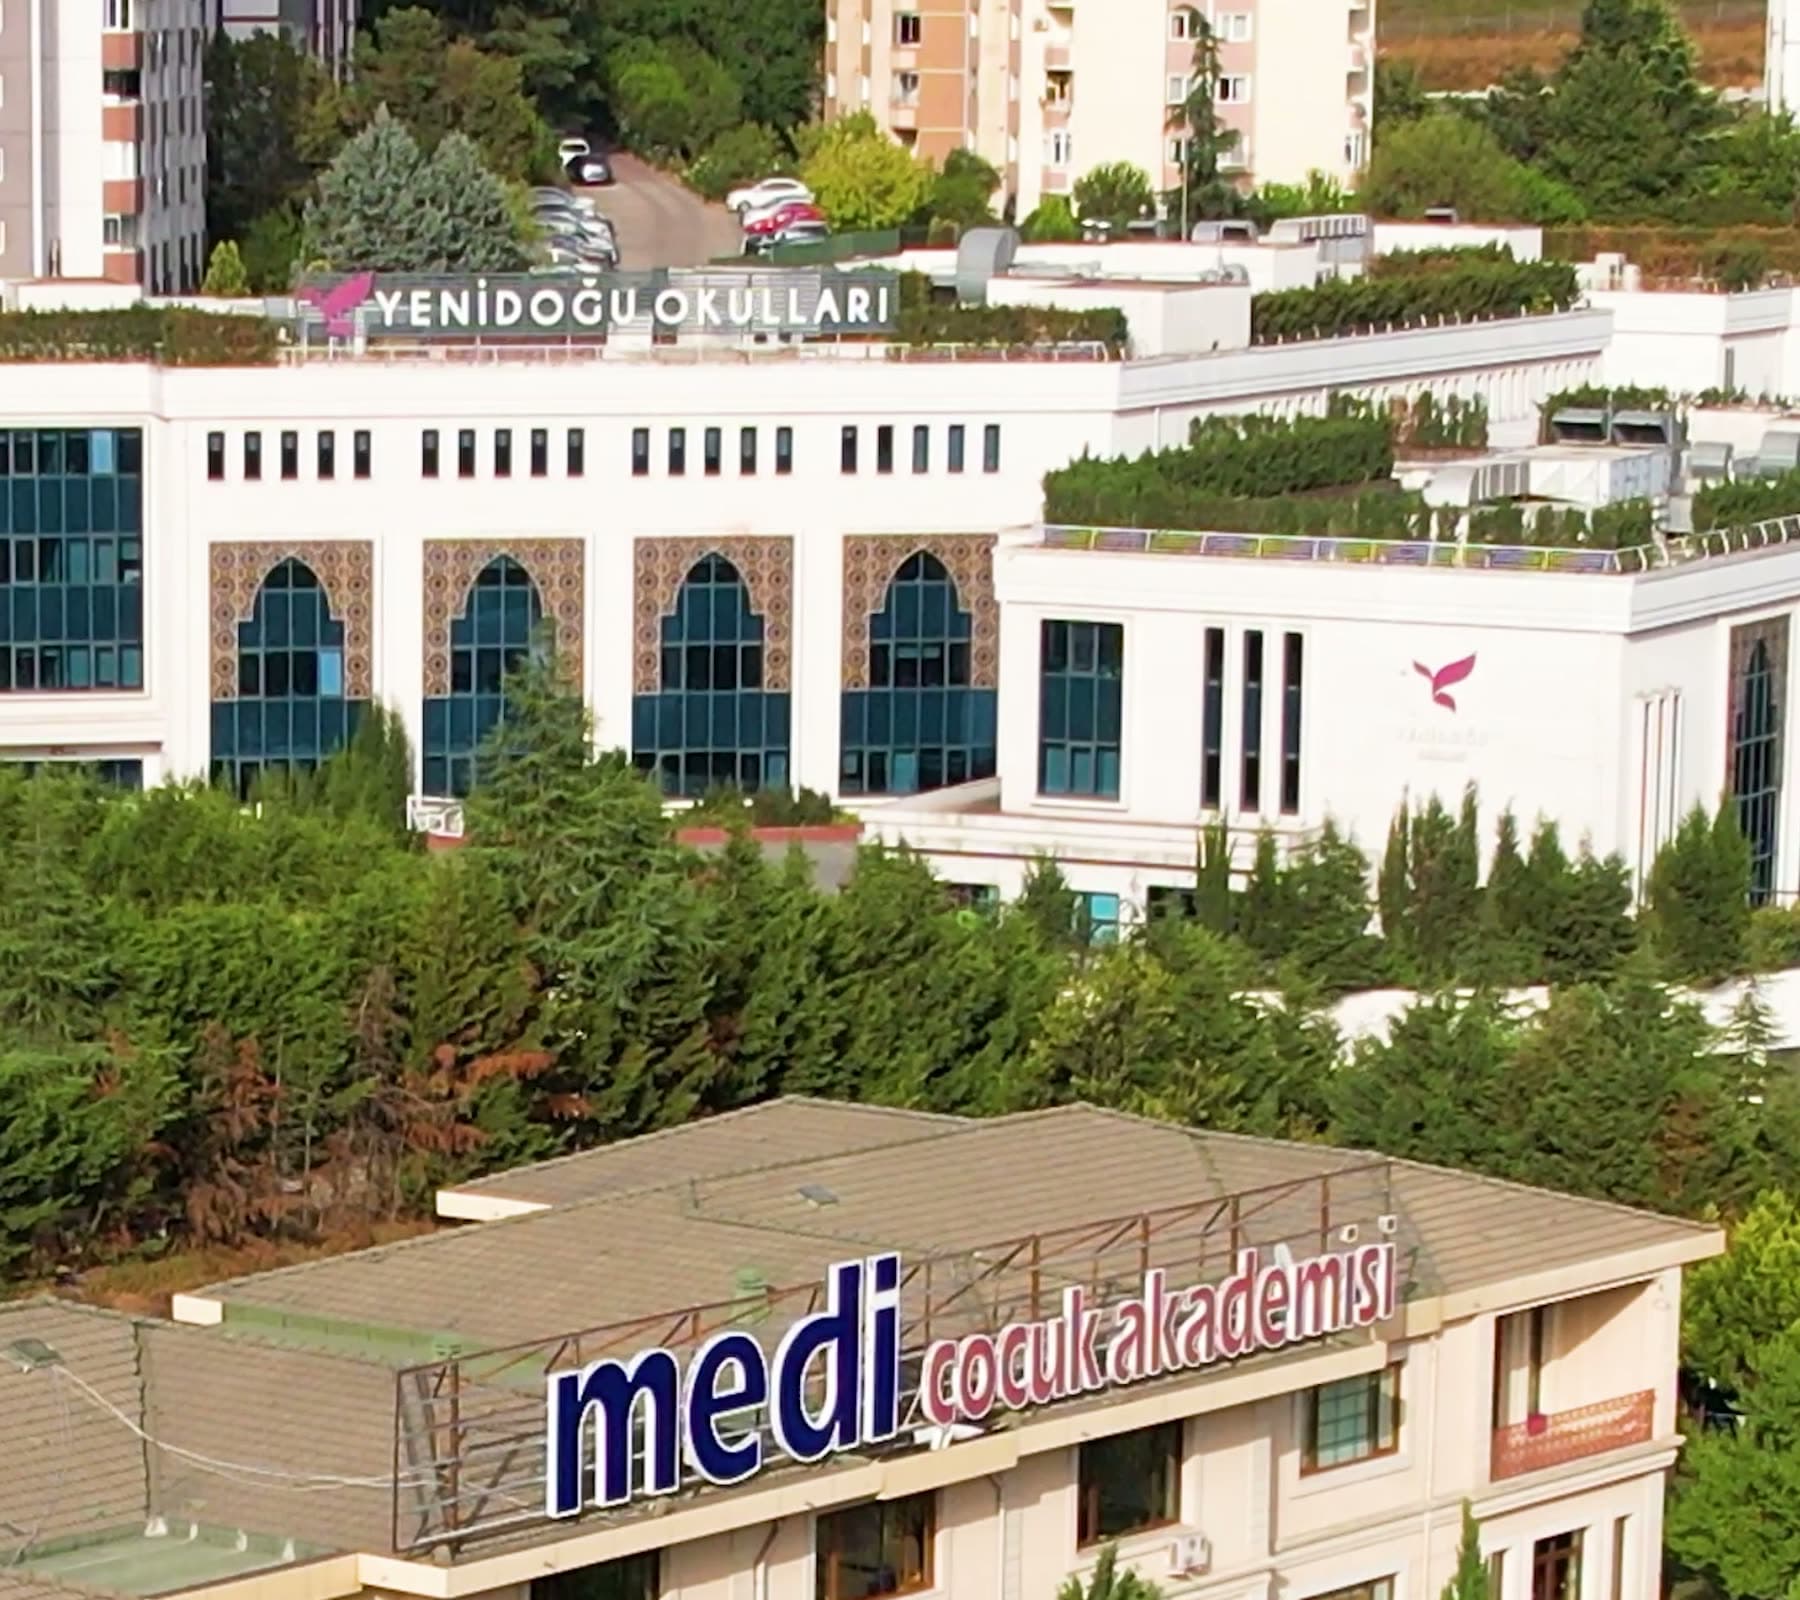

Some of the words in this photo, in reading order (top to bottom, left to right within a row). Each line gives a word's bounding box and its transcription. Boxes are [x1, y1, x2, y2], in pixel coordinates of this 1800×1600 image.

[373, 278, 636, 327] YENİDOĞU
[654, 287, 889, 326] OKULLARI
[546, 1251, 901, 1520] medi
[1104, 1214, 1398, 1384] akademisi
